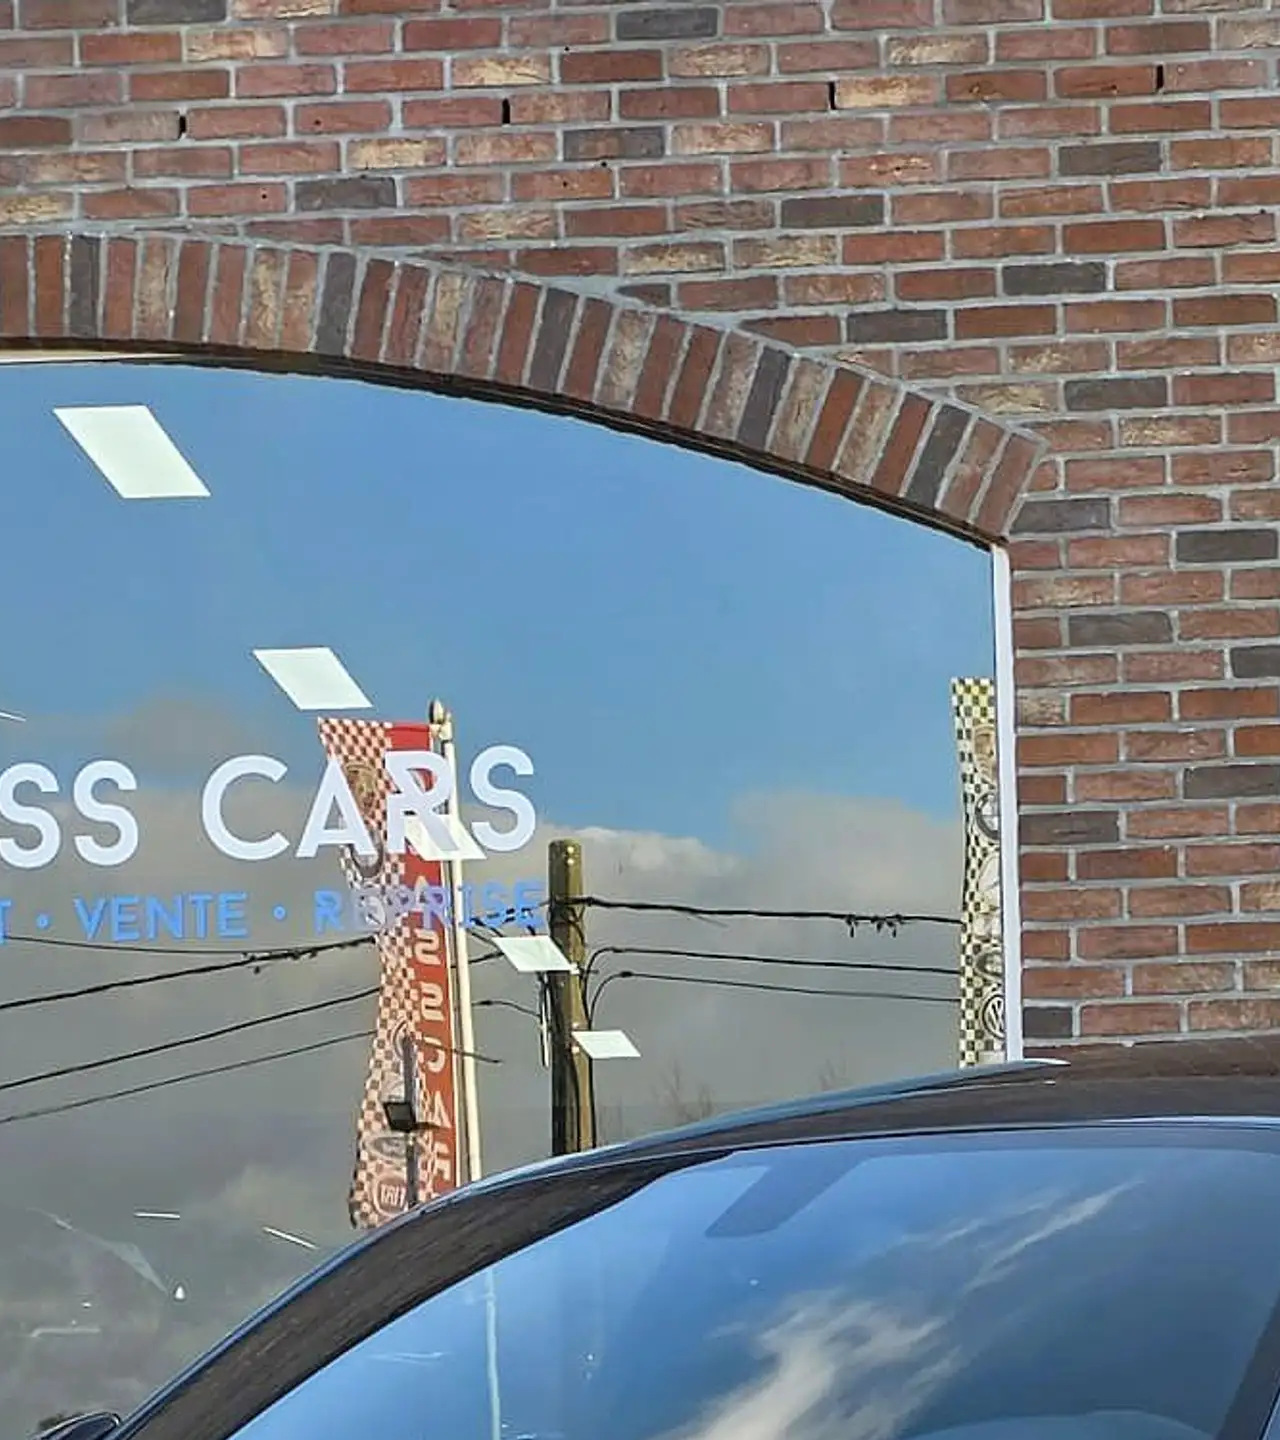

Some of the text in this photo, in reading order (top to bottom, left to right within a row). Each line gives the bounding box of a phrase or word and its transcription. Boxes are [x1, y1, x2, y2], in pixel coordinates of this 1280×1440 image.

[202, 744, 536, 862] CARS
[74, 891, 249, 944] VENTE
[314, 878, 546, 933] REPRISE
